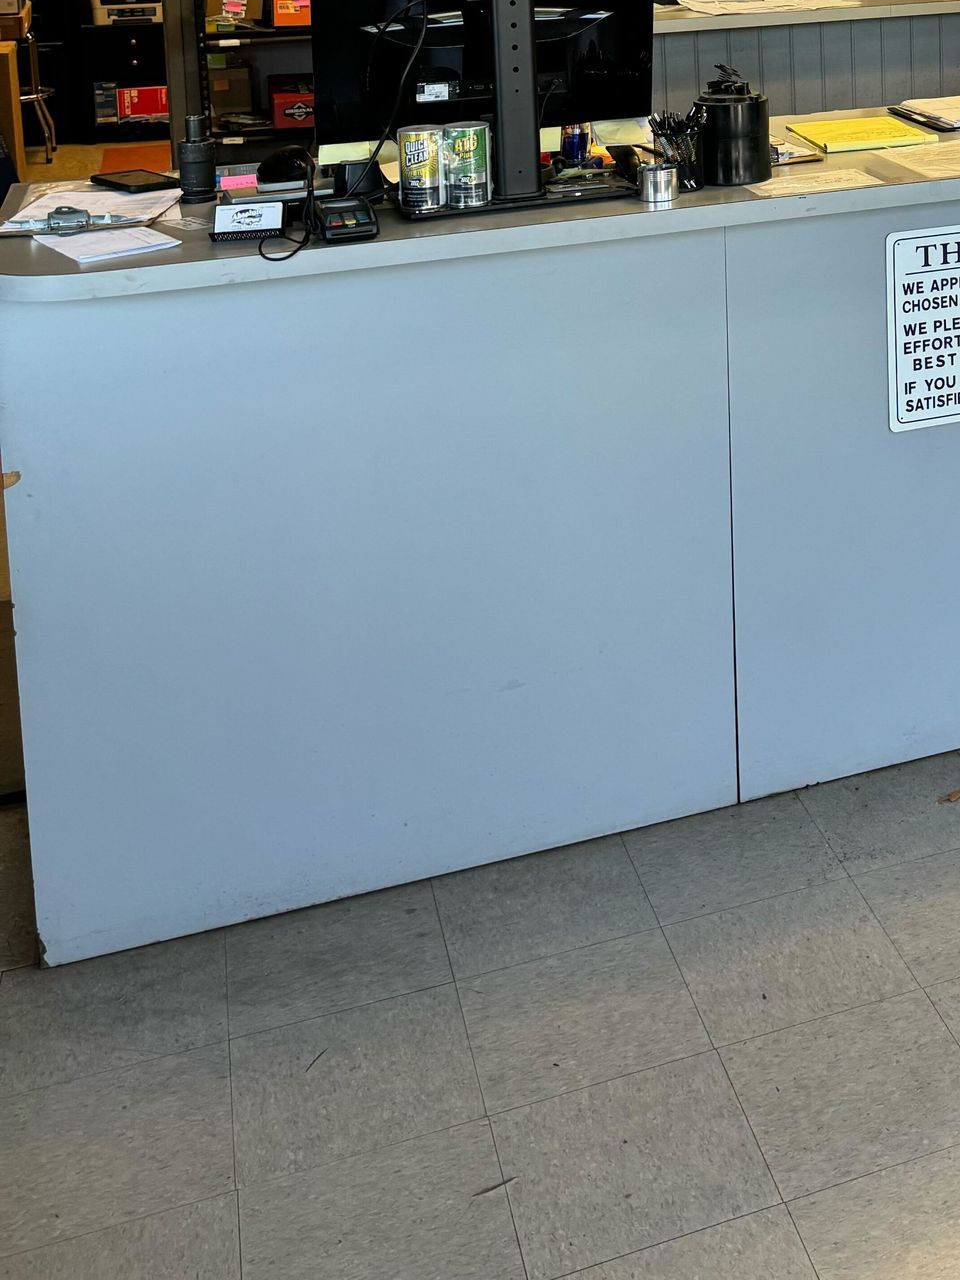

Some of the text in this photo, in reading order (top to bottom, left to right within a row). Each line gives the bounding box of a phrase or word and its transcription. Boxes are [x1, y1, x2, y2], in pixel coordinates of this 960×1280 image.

[405, 139, 428, 153] QUICK
[406, 149, 429, 166] CLEAN
[902, 281, 924, 296] WE
[902, 294, 959, 314] CHOSEN
[903, 322, 927, 337] WE
[913, 353, 957, 372] BEST
[904, 381, 917, 395] IF
[924, 375, 957, 391] YOU
